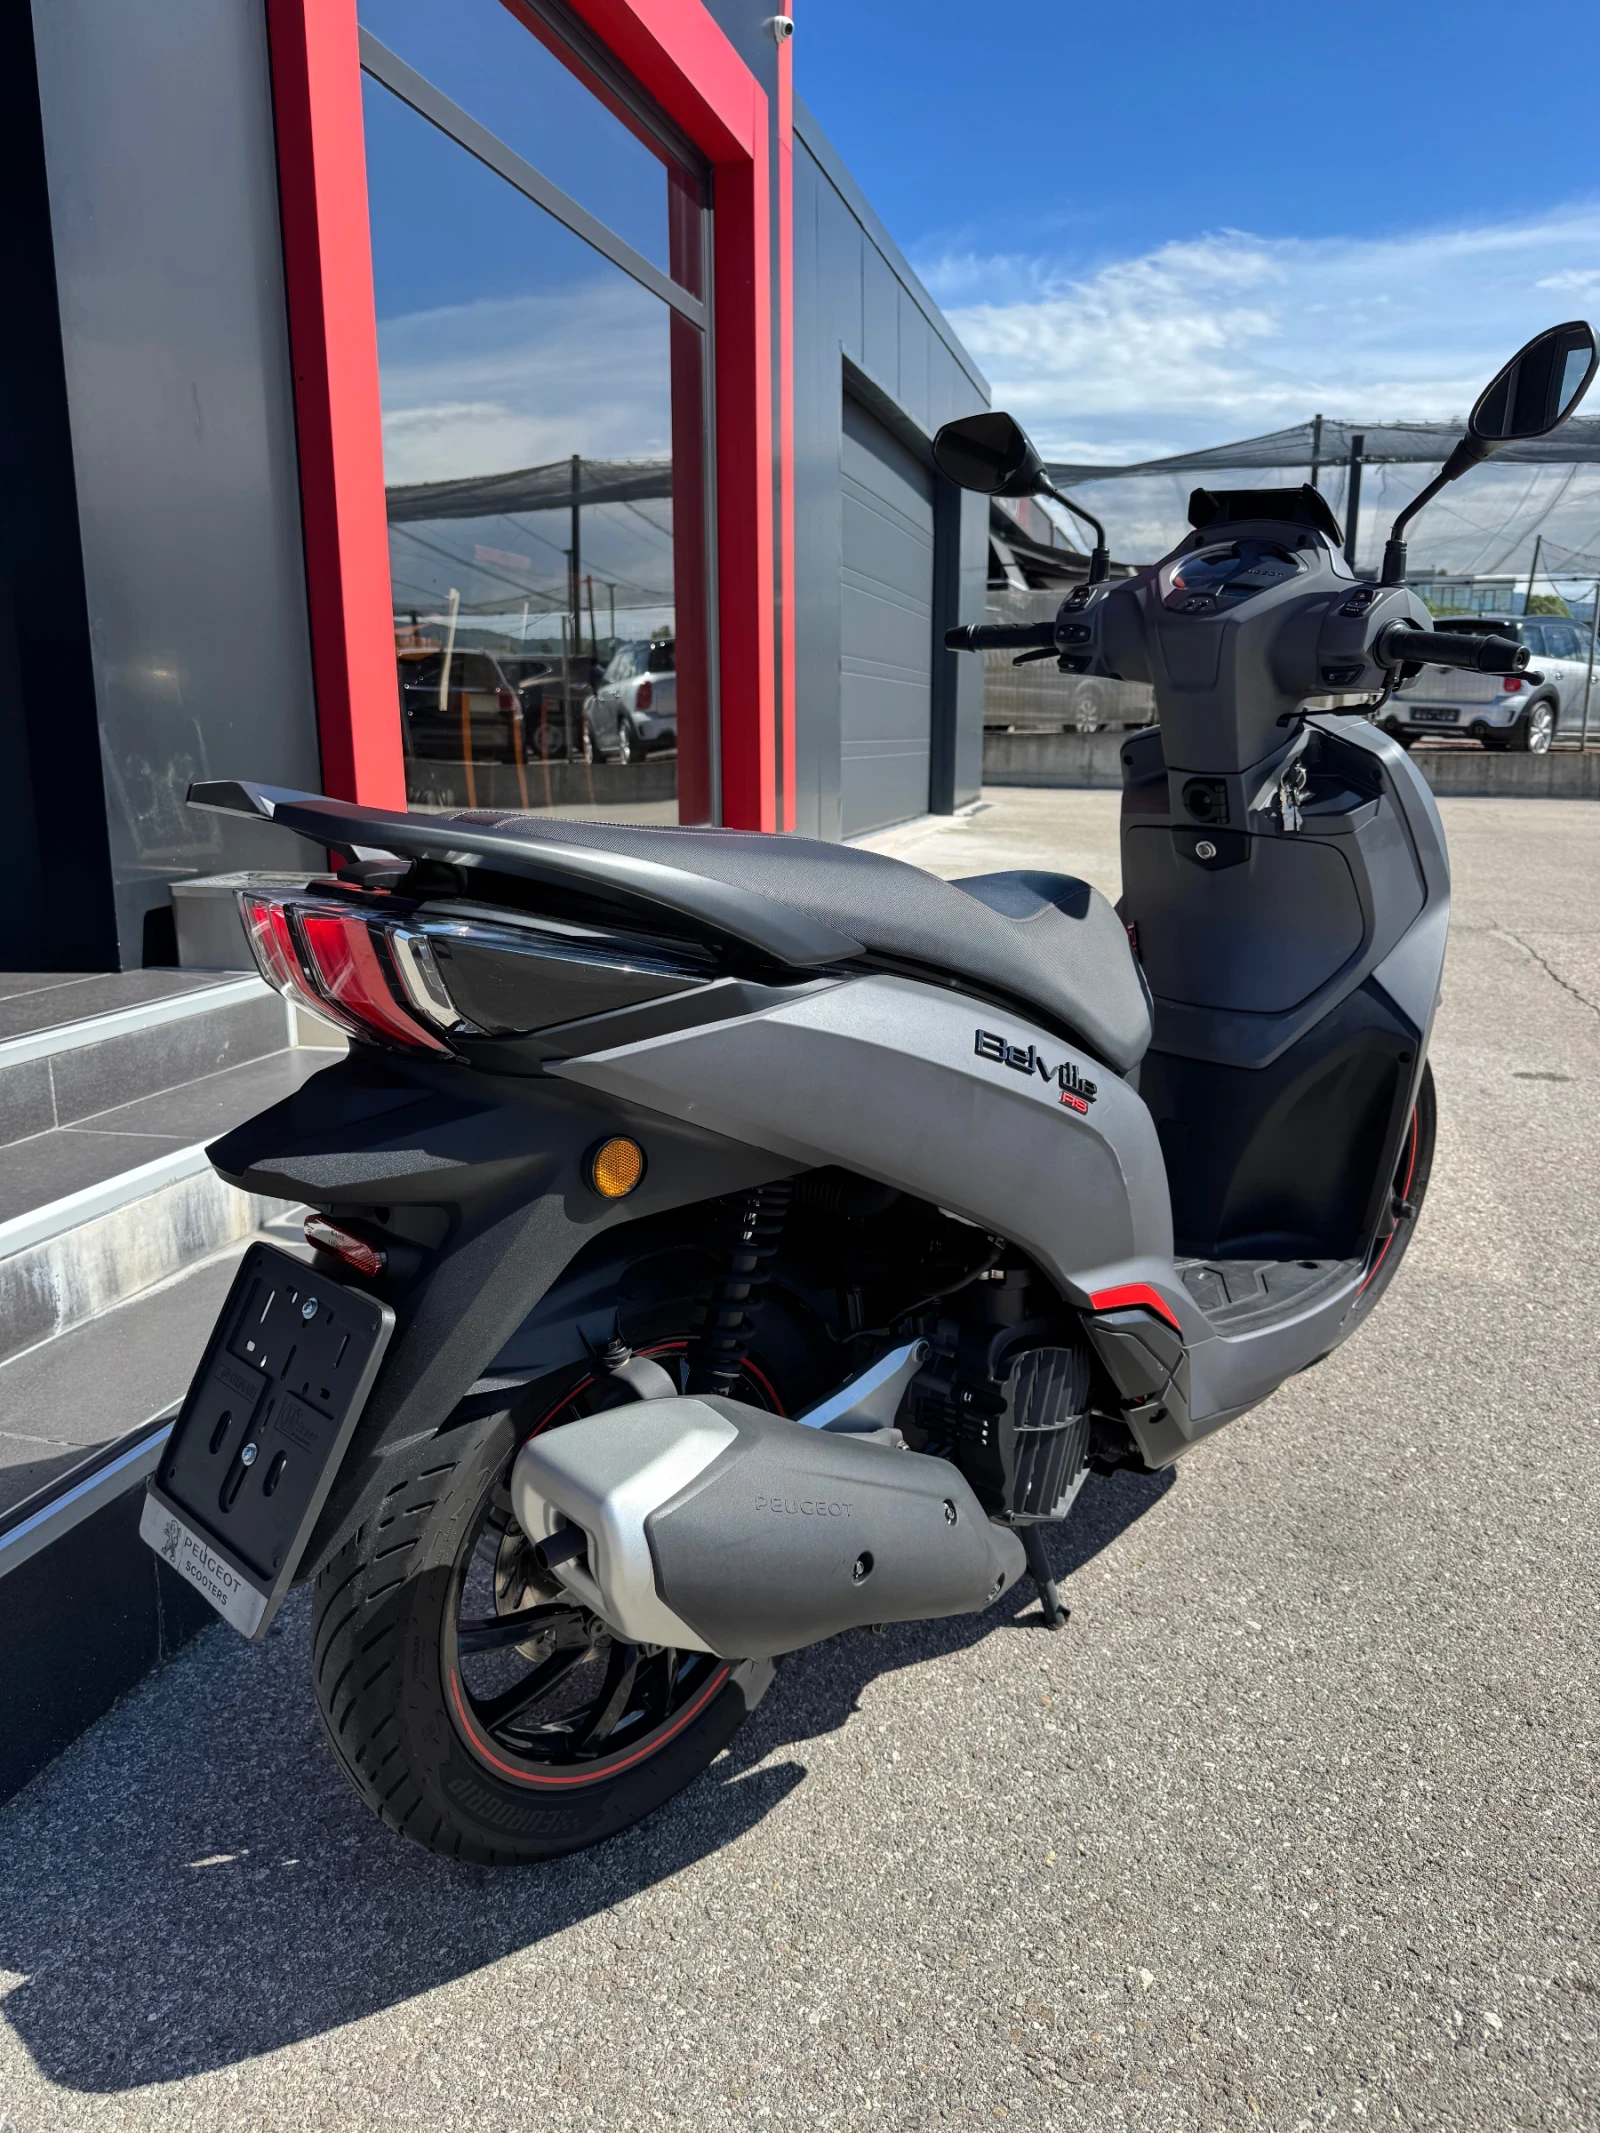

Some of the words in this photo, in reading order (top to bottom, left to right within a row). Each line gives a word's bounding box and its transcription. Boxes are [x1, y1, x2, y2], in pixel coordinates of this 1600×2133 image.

[1060, 1091, 1088, 1114] RS
[755, 1496, 853, 1517] PEUGEOT
[184, 1535, 242, 1594] PEUGEOT
[185, 1560, 228, 1606] SCOOTERS
[447, 1776, 559, 1833] EUROGRIP
